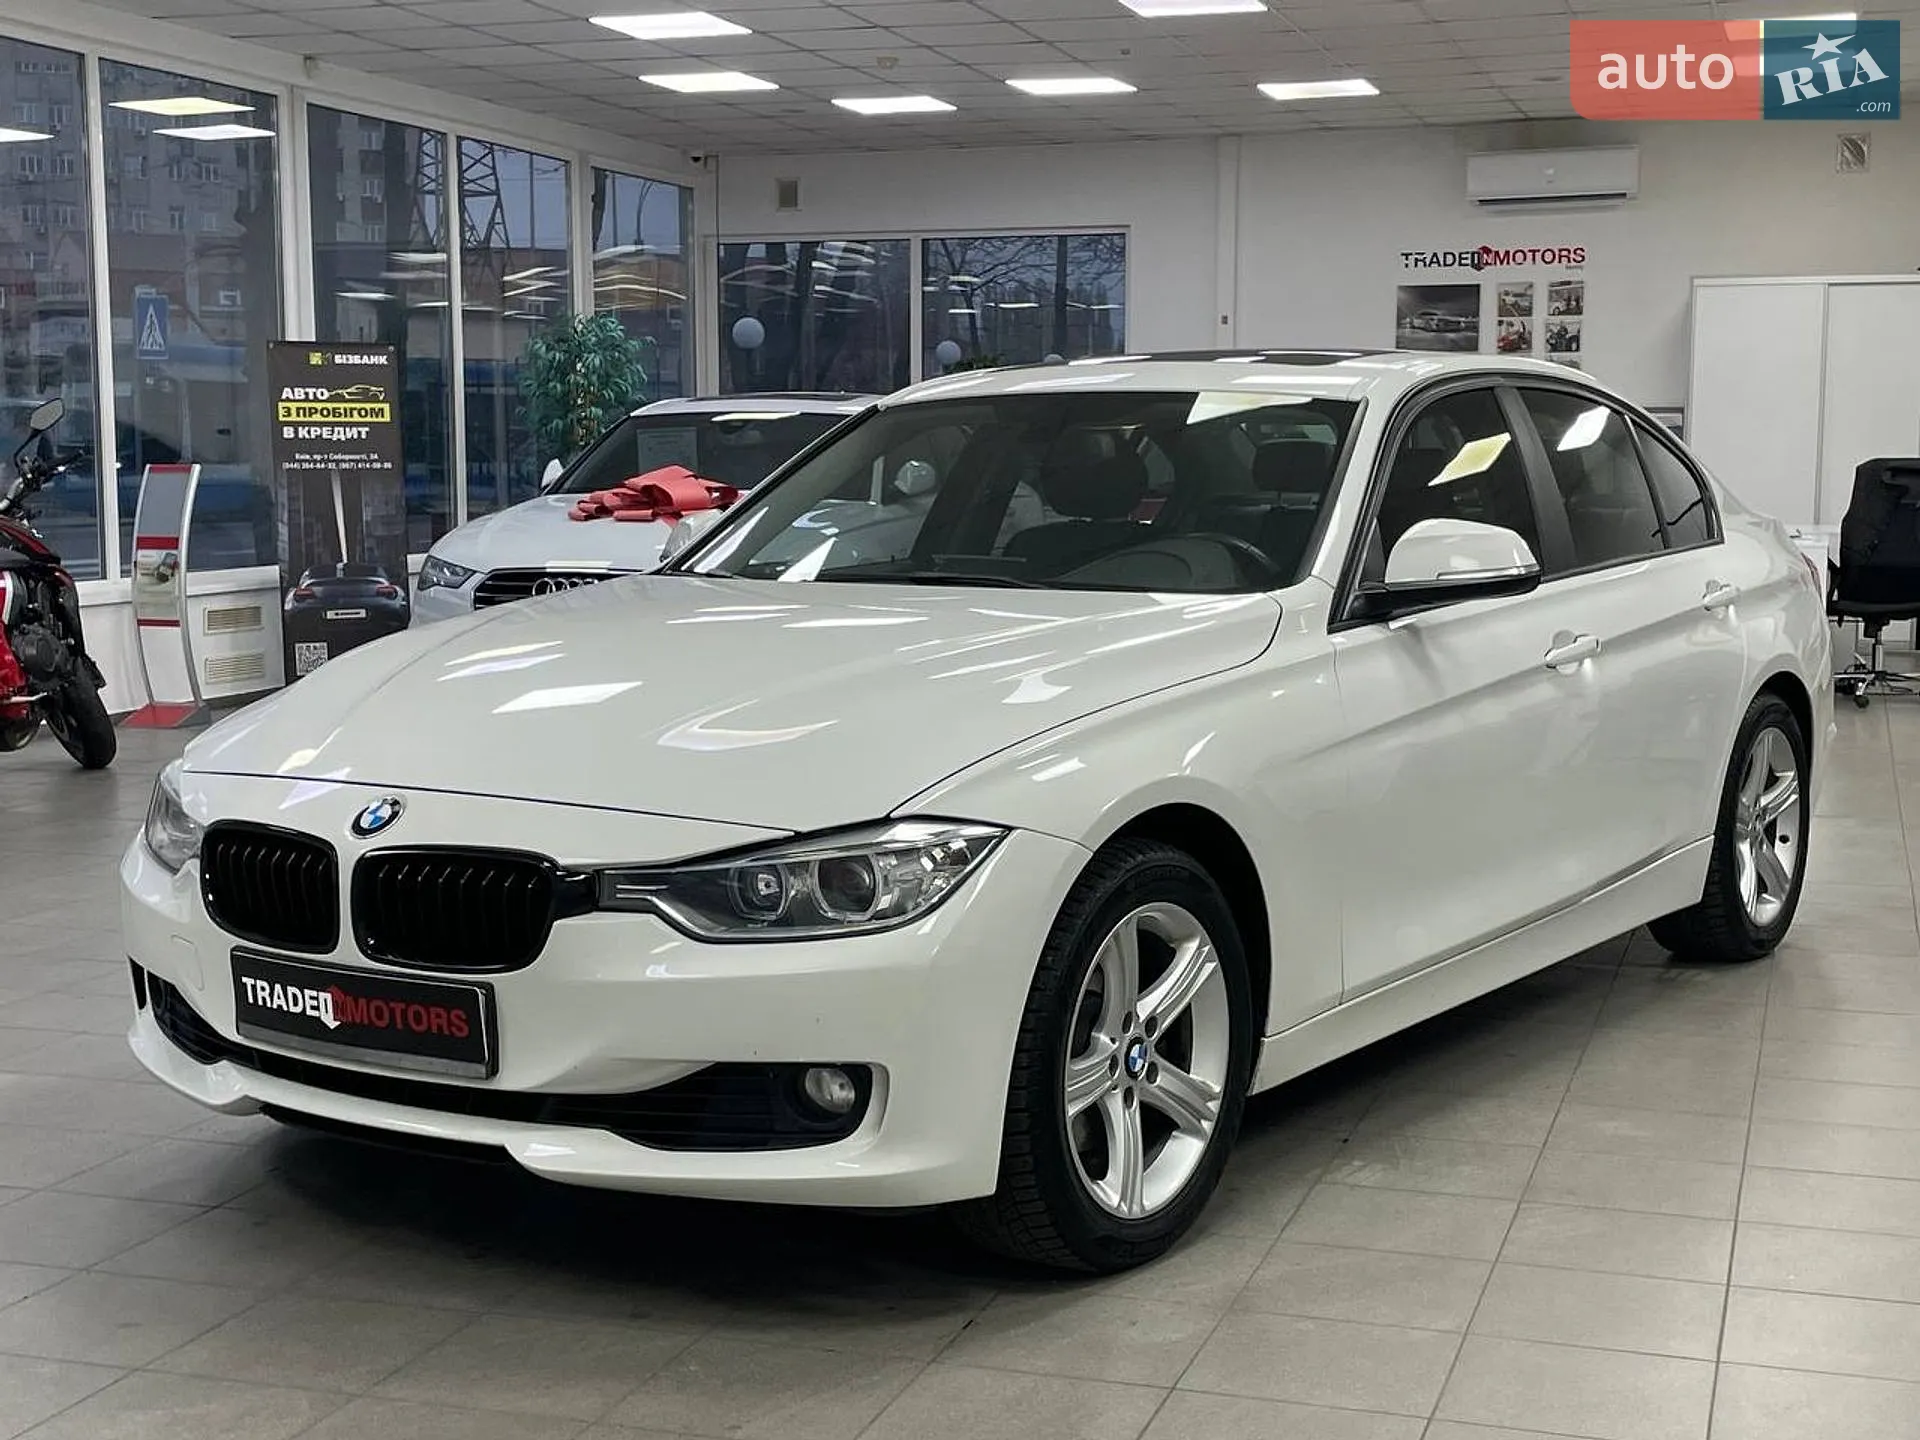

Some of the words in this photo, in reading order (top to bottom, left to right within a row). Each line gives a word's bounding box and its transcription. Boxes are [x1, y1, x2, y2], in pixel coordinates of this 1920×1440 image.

[334, 354, 388, 365] БІЗБАНК
[281, 387, 329, 400] АВТО
[282, 407, 291, 418] З
[296, 407, 385, 418] ПРОБІГОМ
[283, 426, 295, 439] В
[298, 426, 370, 440] КРЕДИТ
